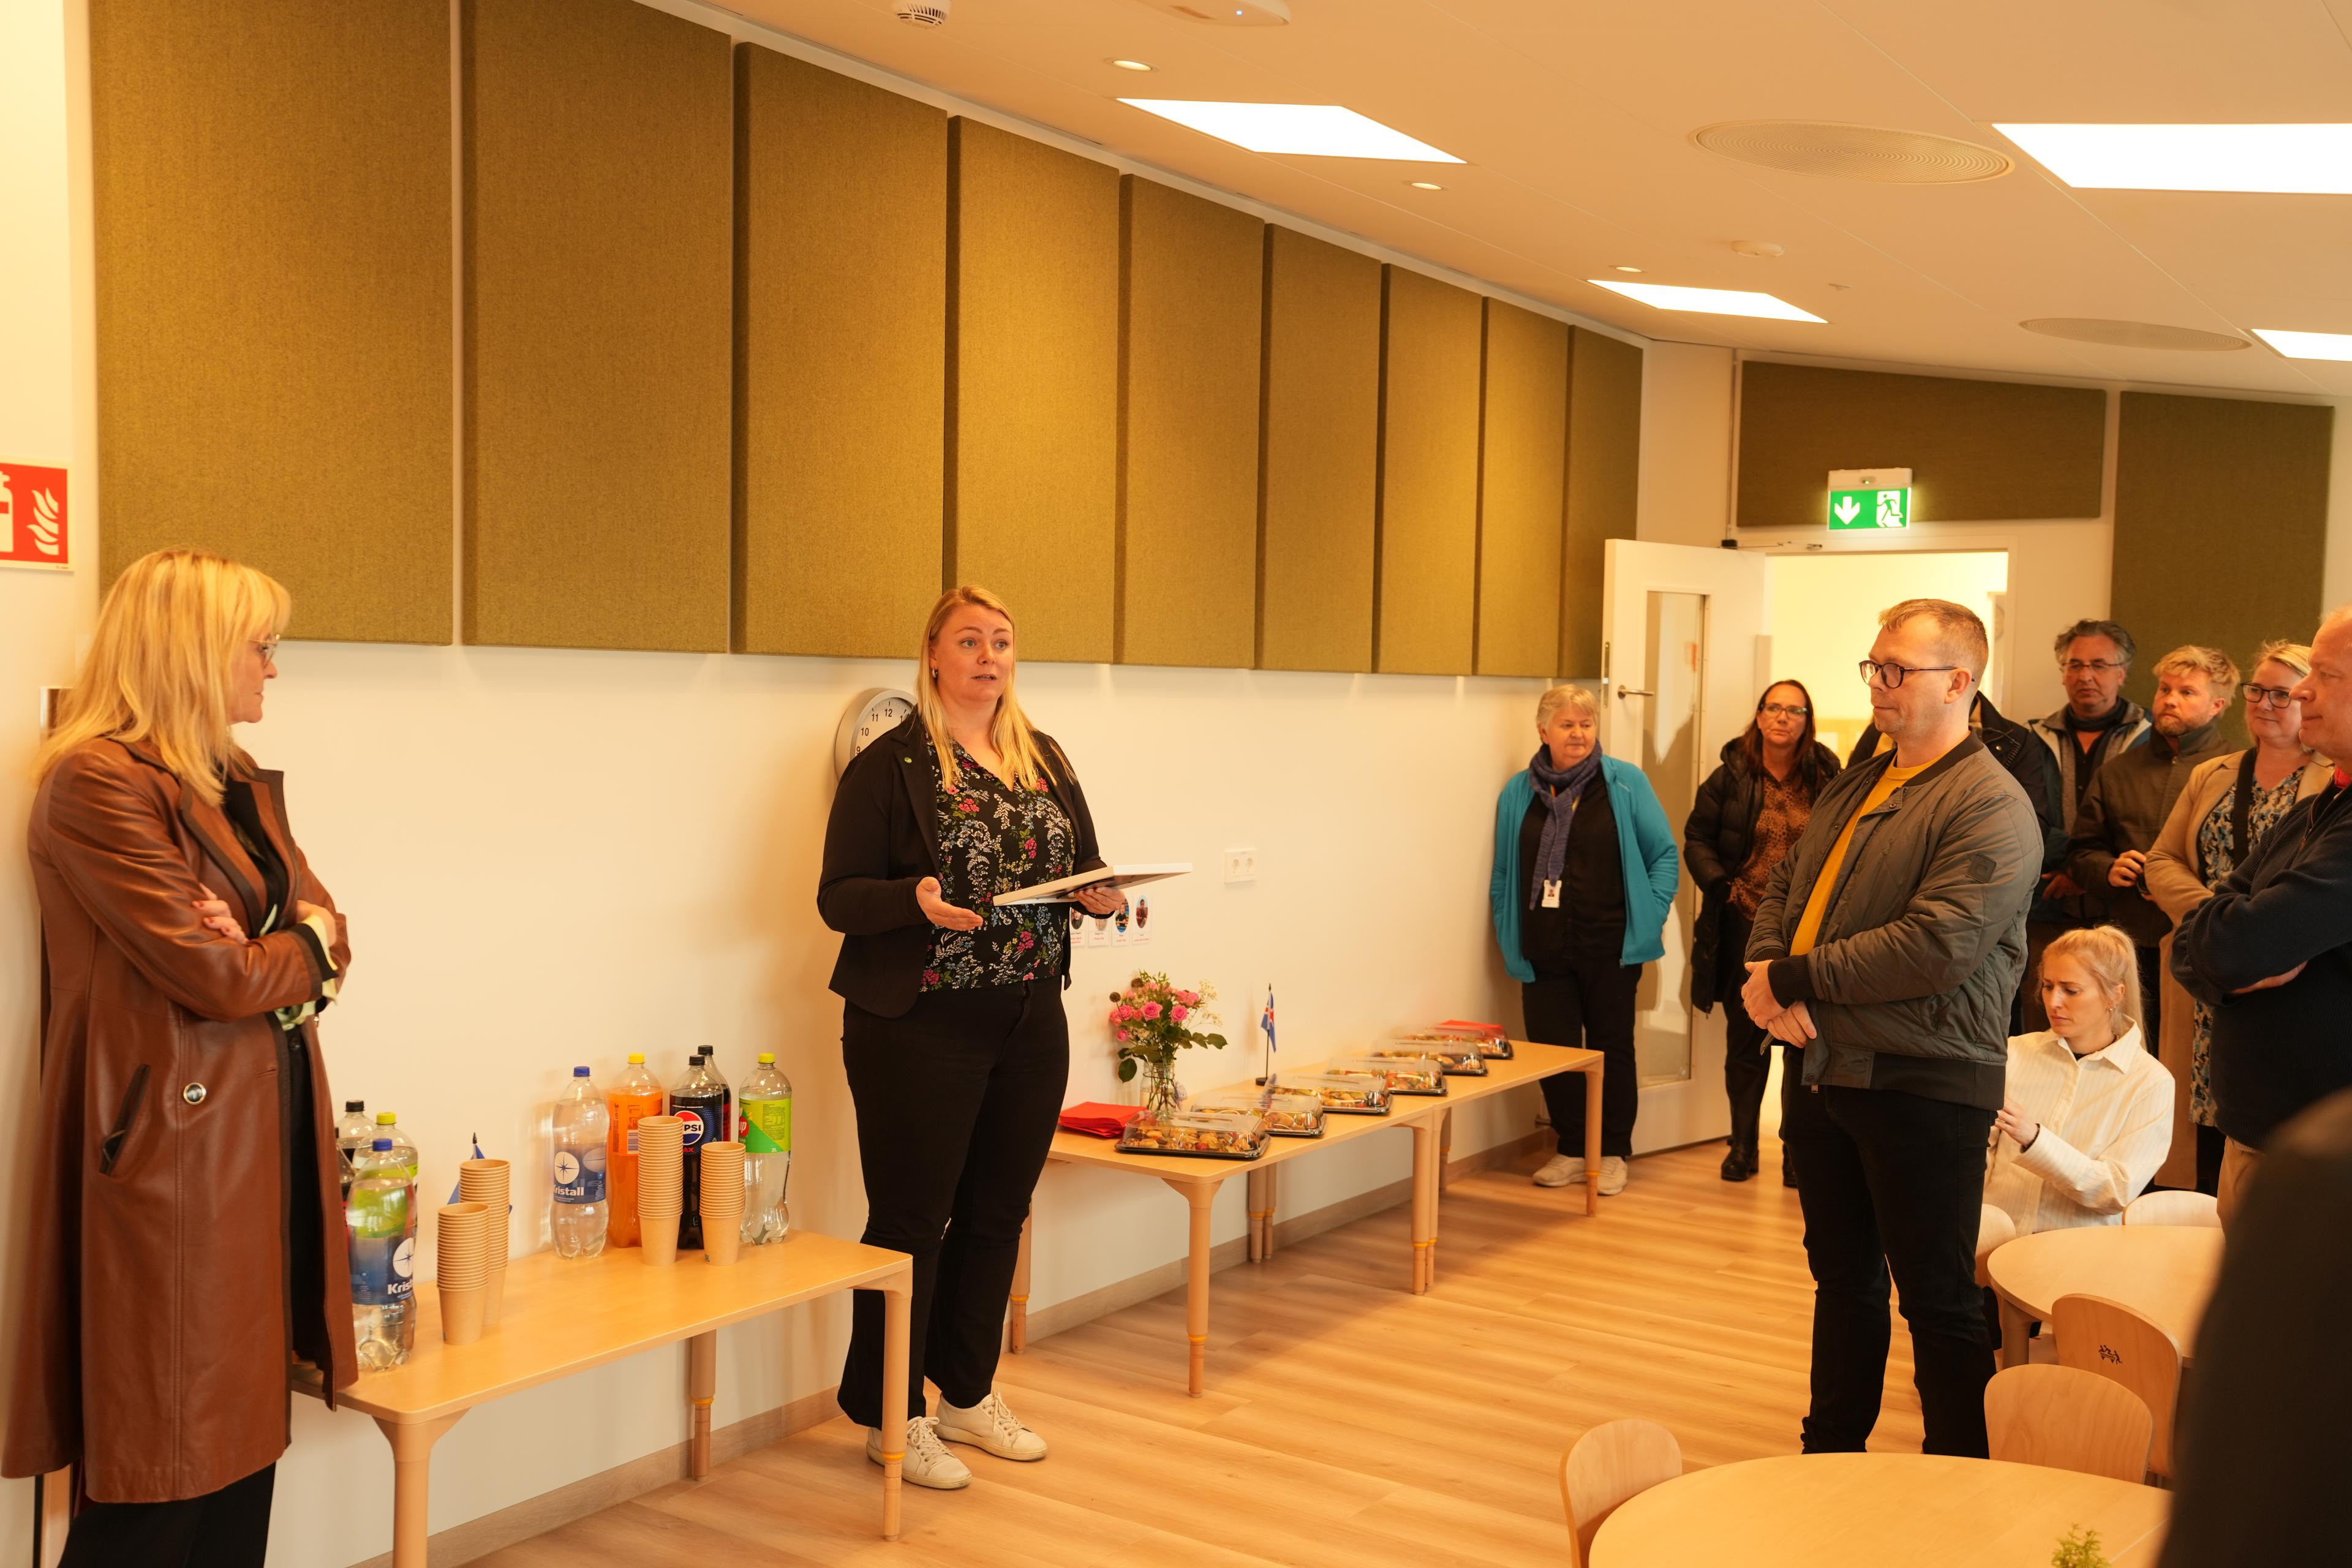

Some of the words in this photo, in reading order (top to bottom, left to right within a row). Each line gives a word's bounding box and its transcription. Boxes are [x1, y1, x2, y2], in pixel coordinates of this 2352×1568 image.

[884, 709, 892, 717] 12
[861, 728, 869, 736] 10
[856, 746, 861, 755] 9
